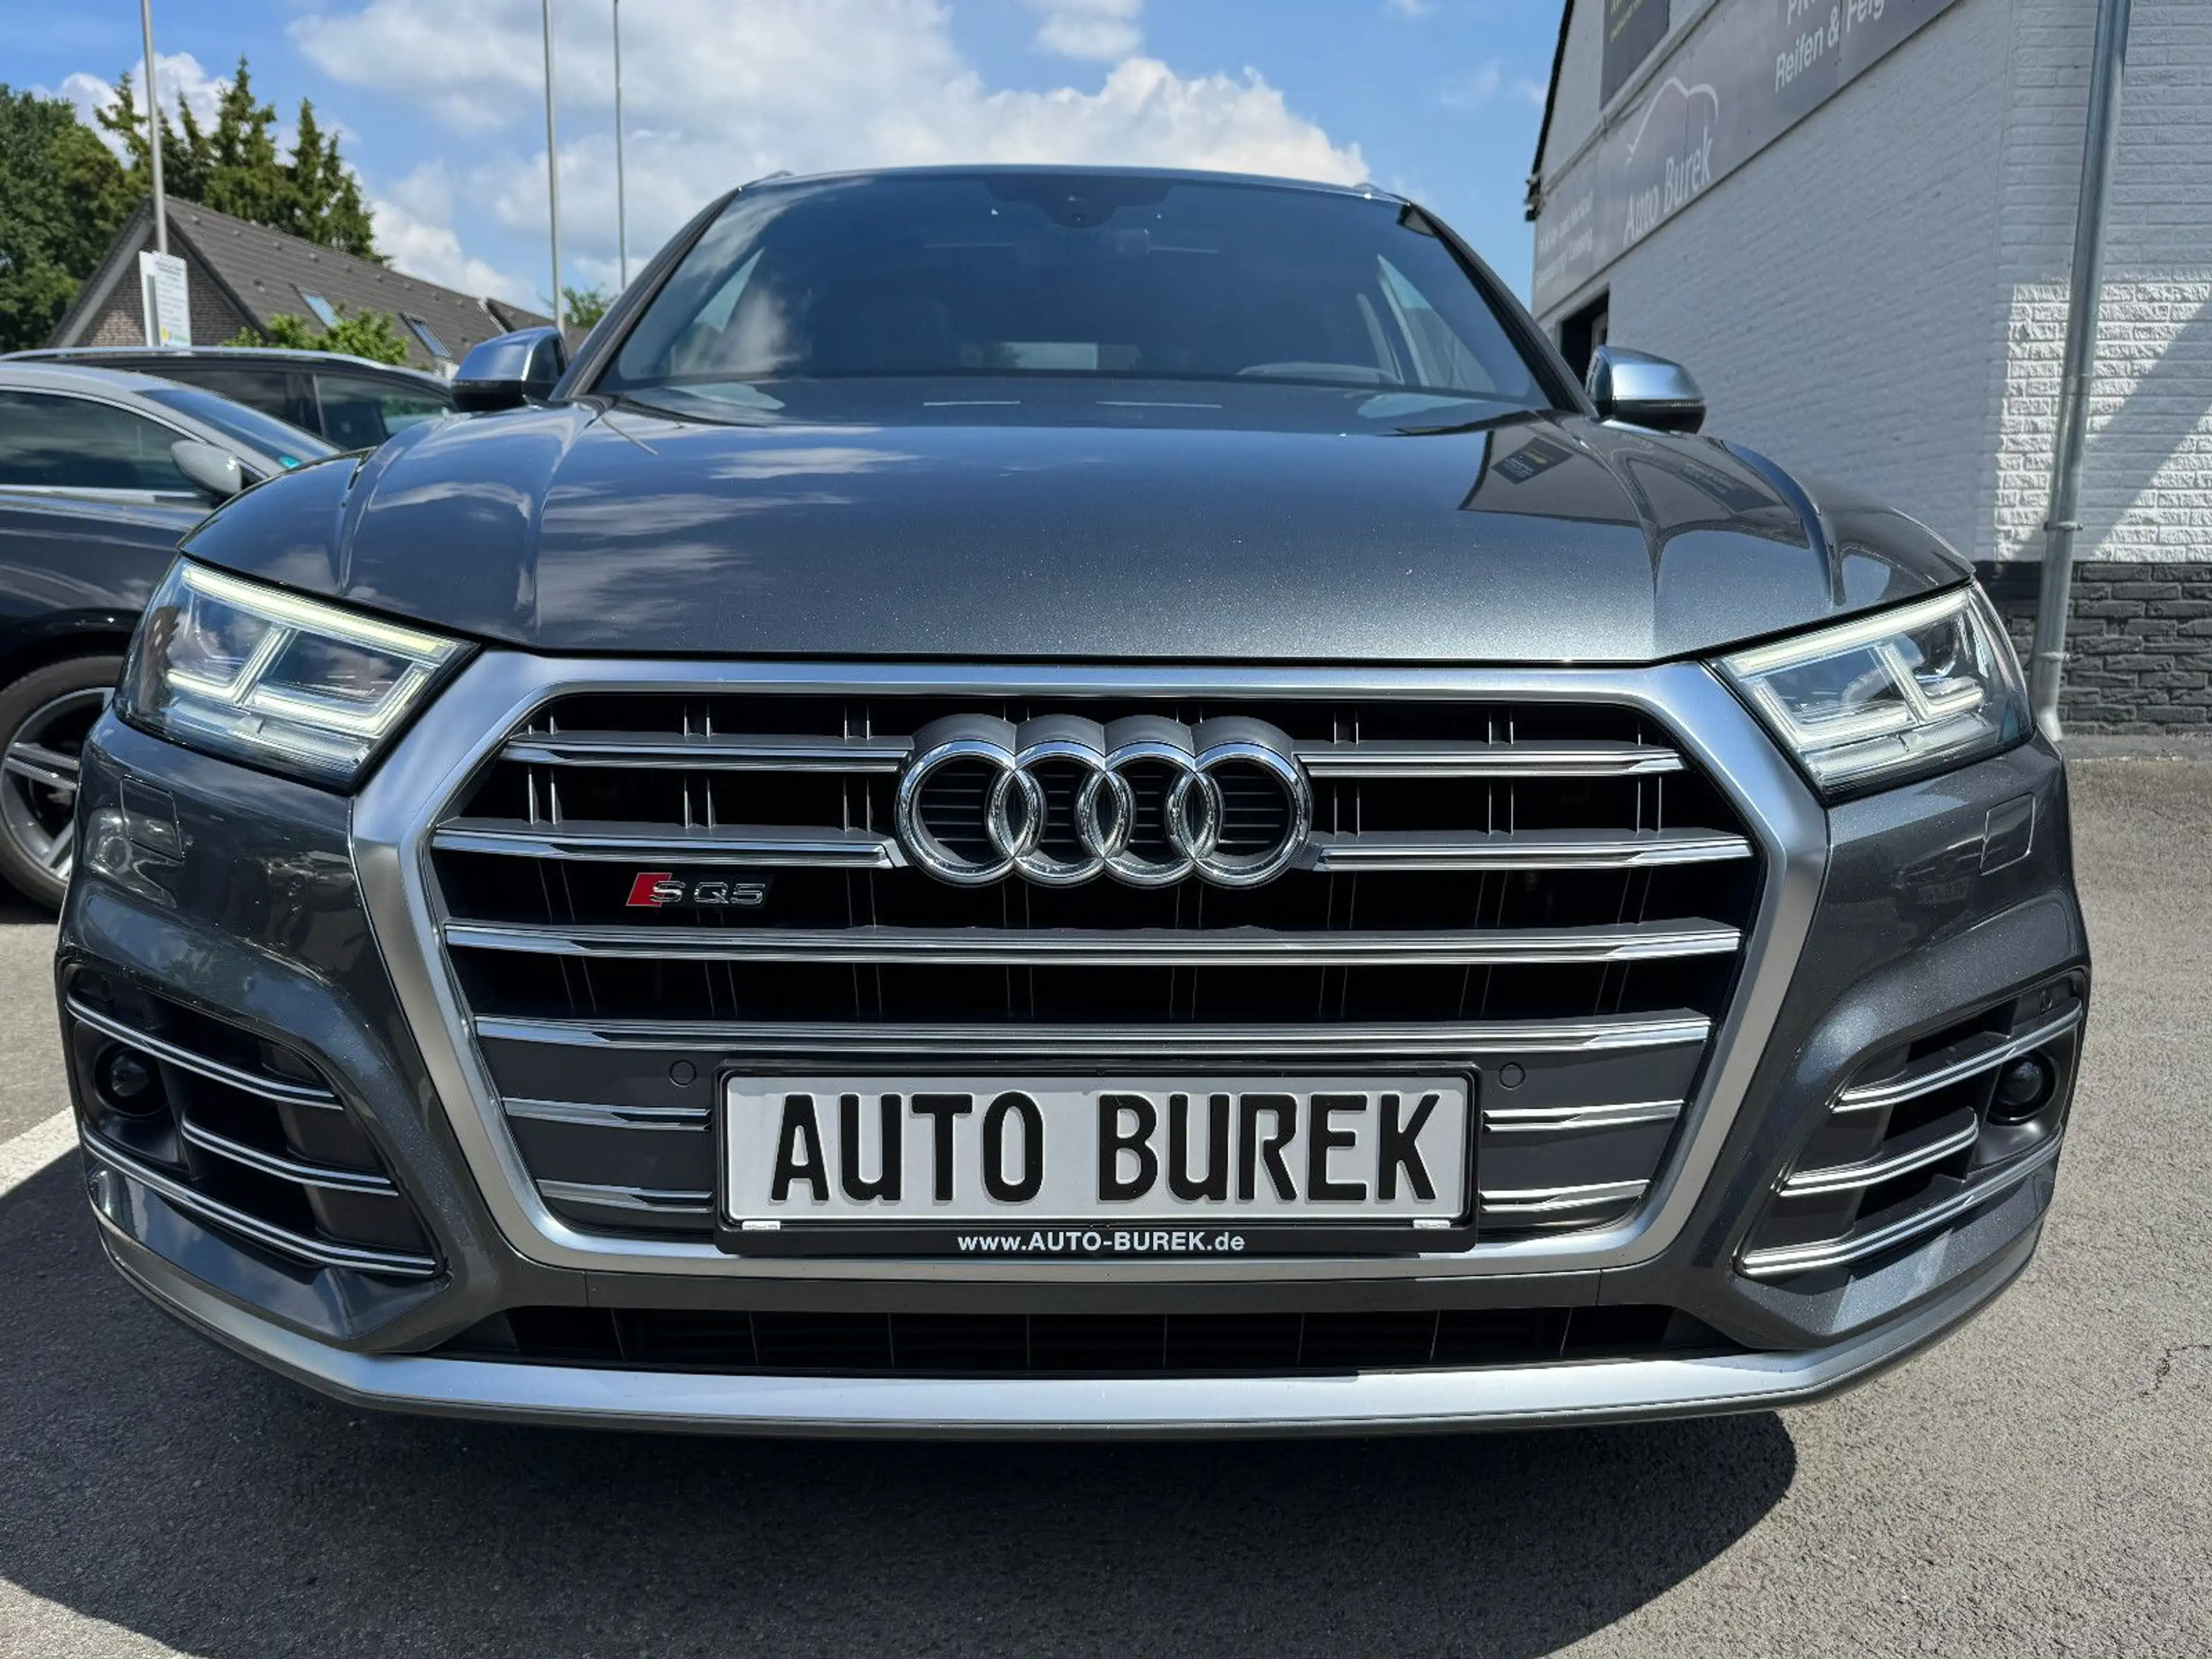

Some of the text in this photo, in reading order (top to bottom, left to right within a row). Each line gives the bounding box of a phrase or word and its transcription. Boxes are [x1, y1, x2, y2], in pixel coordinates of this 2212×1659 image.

[1775, 26, 1824, 93] Reifen
[1828, 5, 1839, 48] &
[1623, 185, 1658, 248] Auto
[1662, 125, 1713, 215] Burek
[649, 880, 766, 904] SQ5
[771, 1091, 1440, 1202] AUTO BUREK
[957, 1231, 1245, 1251] www.AUTO-BUREK.de
